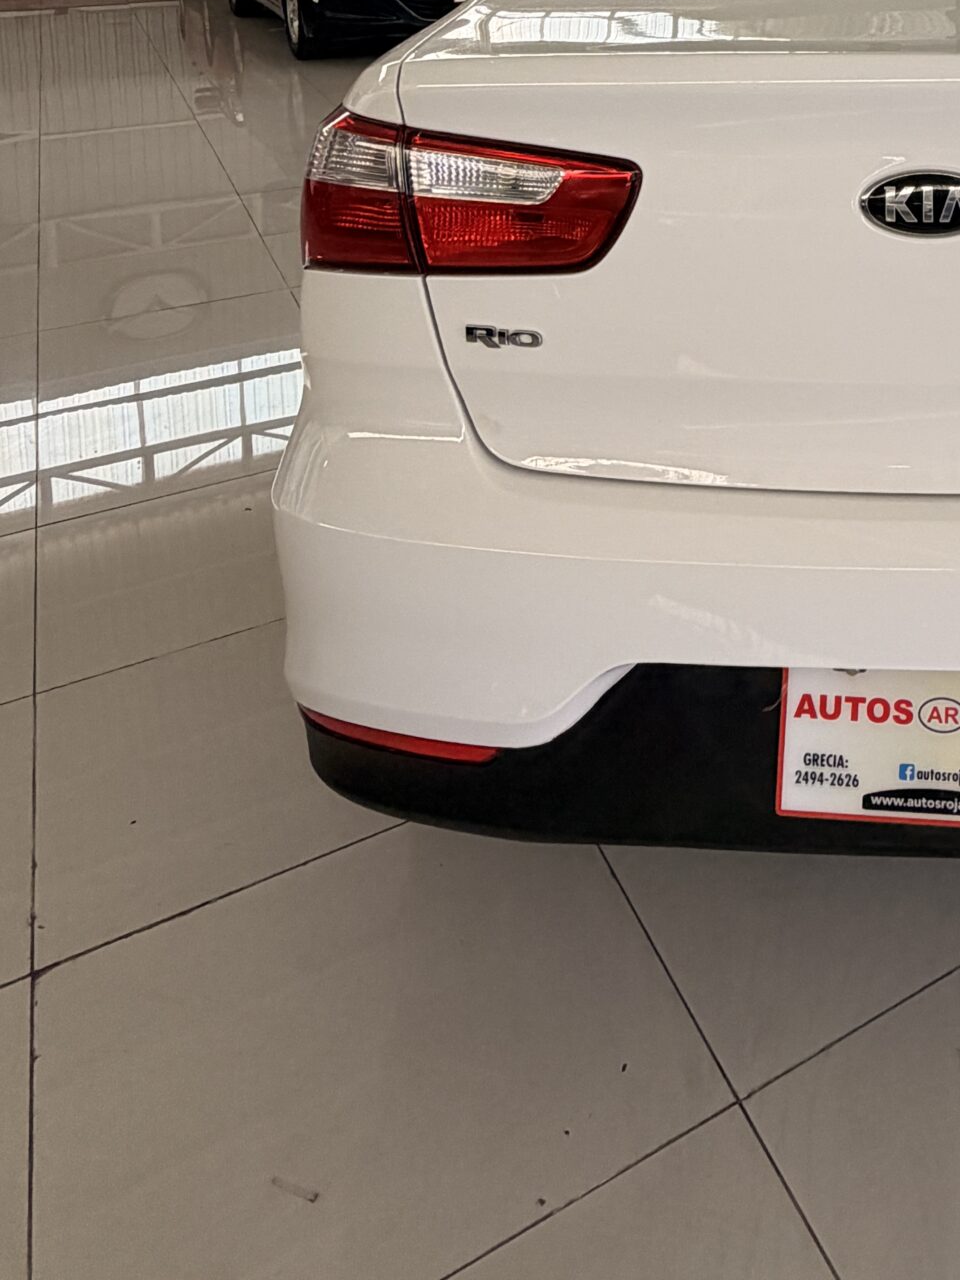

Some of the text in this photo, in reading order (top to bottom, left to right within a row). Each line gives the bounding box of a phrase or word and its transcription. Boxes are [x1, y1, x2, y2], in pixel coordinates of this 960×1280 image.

[793, 693, 914, 725] AUTOS
[927, 706, 959, 725] AR
[803, 752, 849, 769] GRECIA:
[794, 769, 860, 788] 2494-2626
